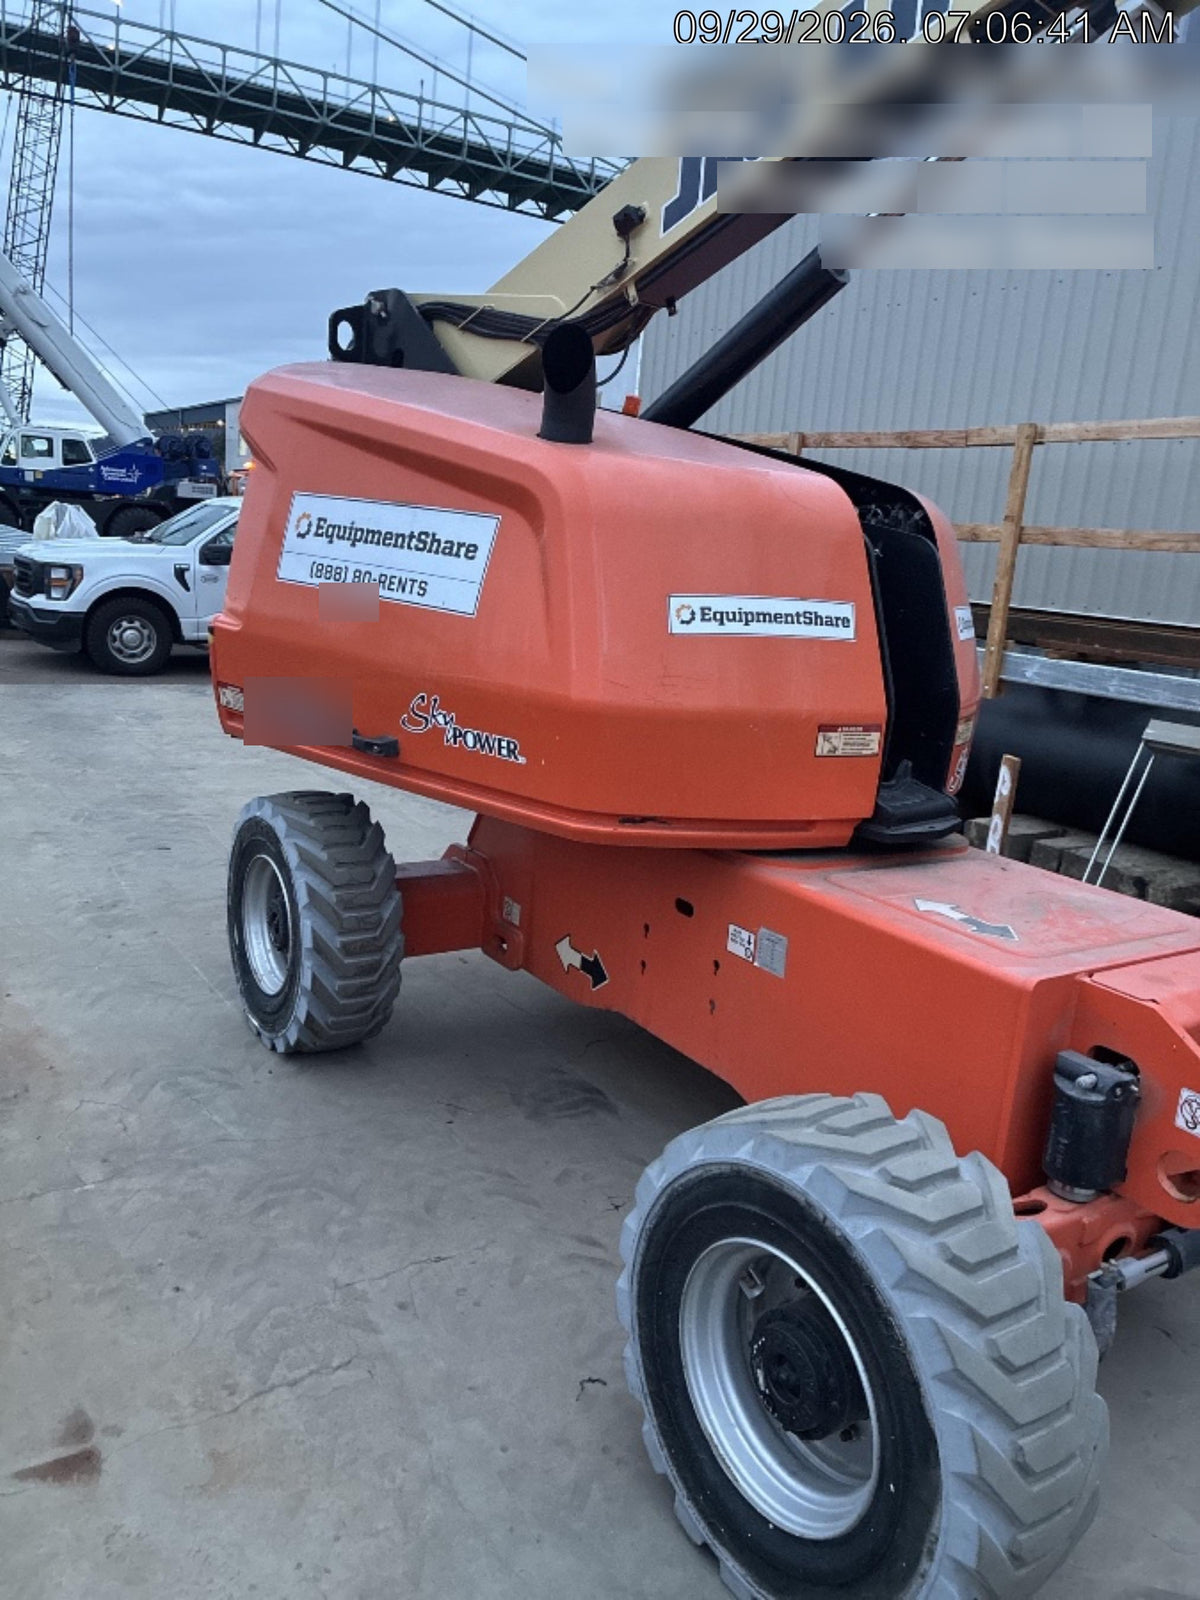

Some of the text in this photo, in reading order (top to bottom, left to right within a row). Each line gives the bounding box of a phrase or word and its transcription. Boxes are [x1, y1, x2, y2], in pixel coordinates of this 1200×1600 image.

[313, 517, 478, 560] EquipmentShare
[310, 561, 428, 597] (888) 80-RENTS
[700, 606, 850, 629] EquipmentShare
[400, 693, 455, 745] Sky
[451, 725, 520, 762] POWER
